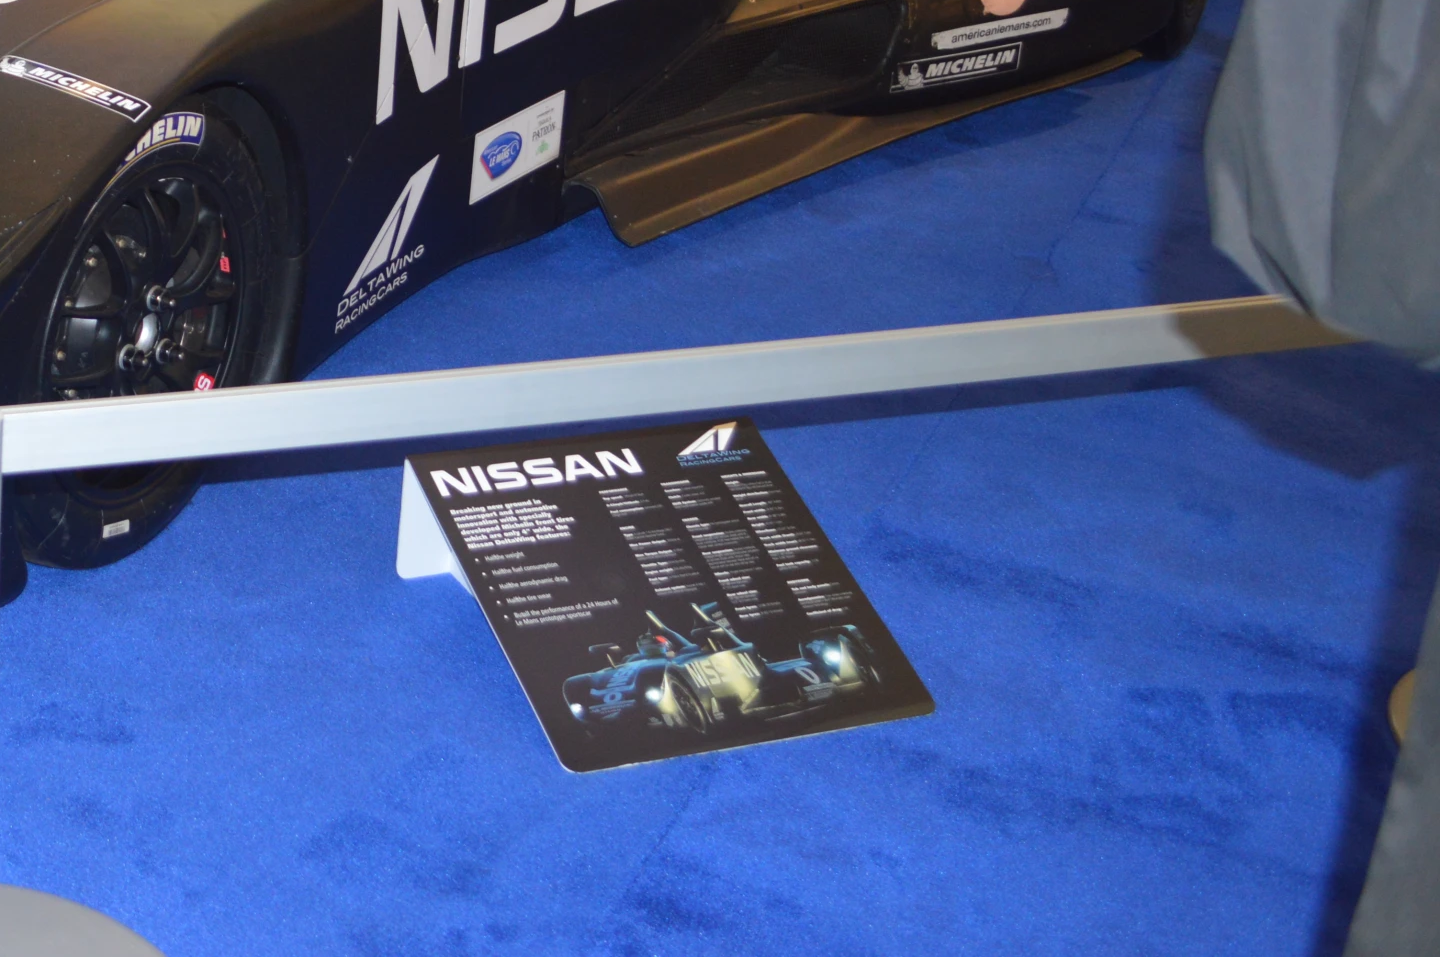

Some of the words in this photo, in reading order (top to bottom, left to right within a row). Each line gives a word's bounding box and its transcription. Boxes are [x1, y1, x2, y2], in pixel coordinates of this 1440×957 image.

[28, 65, 142, 111] MICHELIN
[925, 49, 1016, 79] MICHELIN
[334, 271, 408, 334] RACINGCARS
[337, 244, 425, 317] DELTAWING
[430, 448, 644, 497] NISSAN
